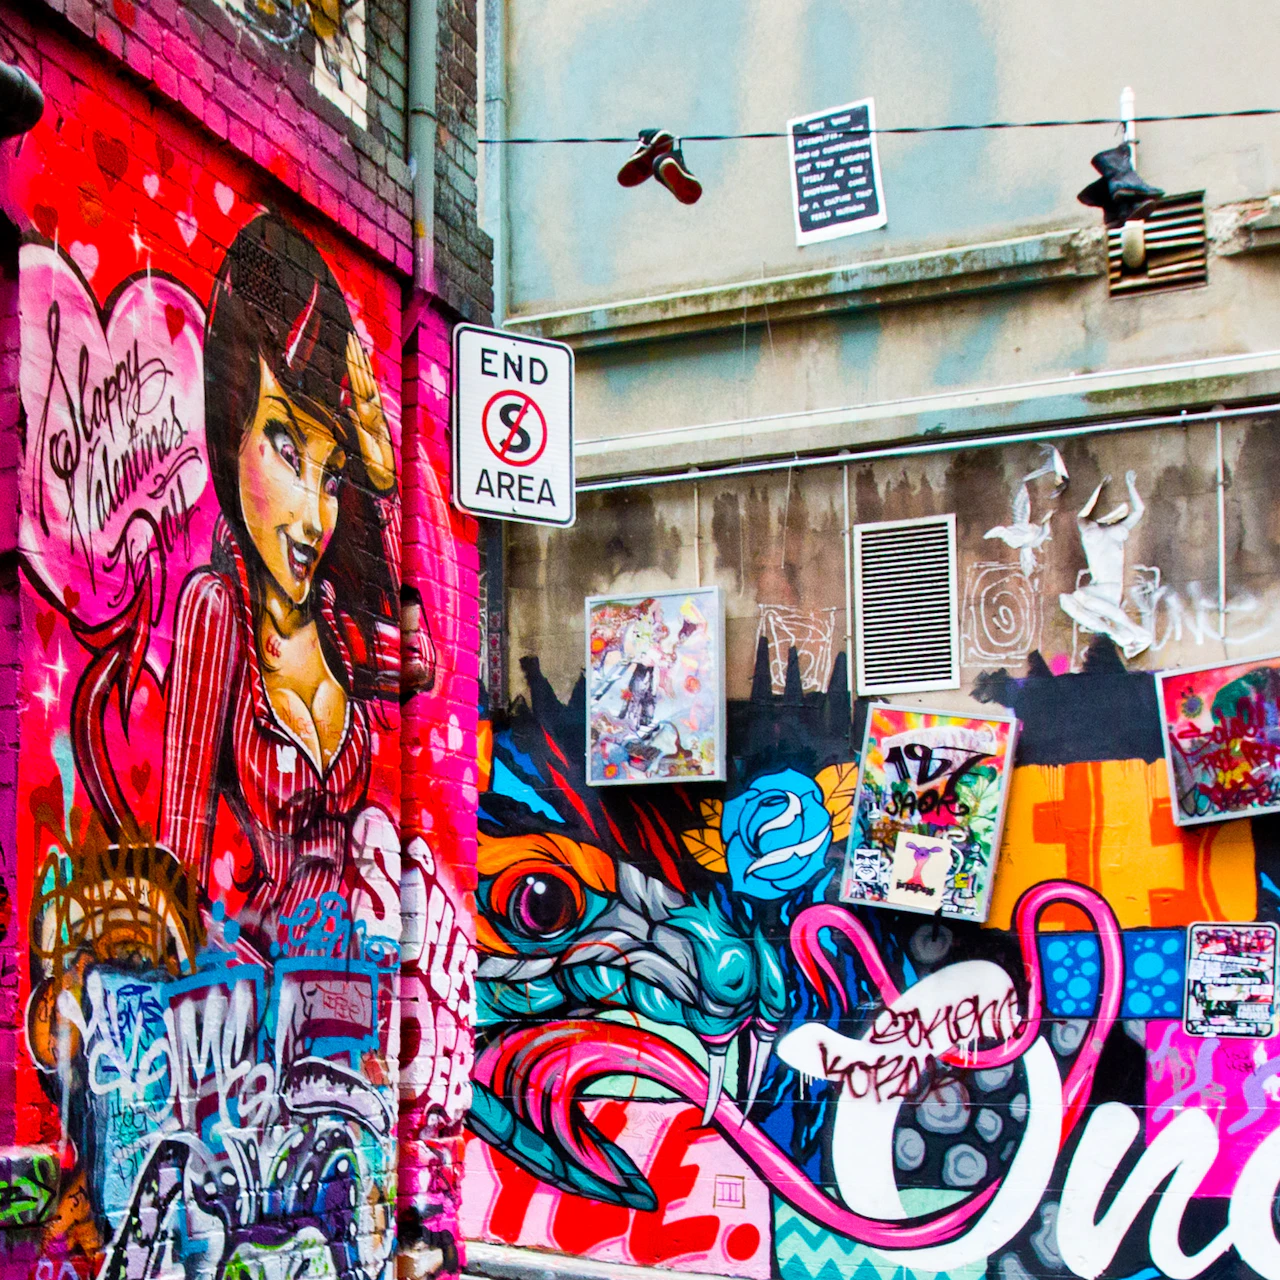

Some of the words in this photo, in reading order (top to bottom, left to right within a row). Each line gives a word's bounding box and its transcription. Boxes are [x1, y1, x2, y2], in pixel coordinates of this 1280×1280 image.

[481, 347, 549, 386] END
[32, 300, 173, 538] Happy
[499, 402, 531, 454] S
[475, 468, 556, 507] AREA
[103, 474, 201, 628] Day
